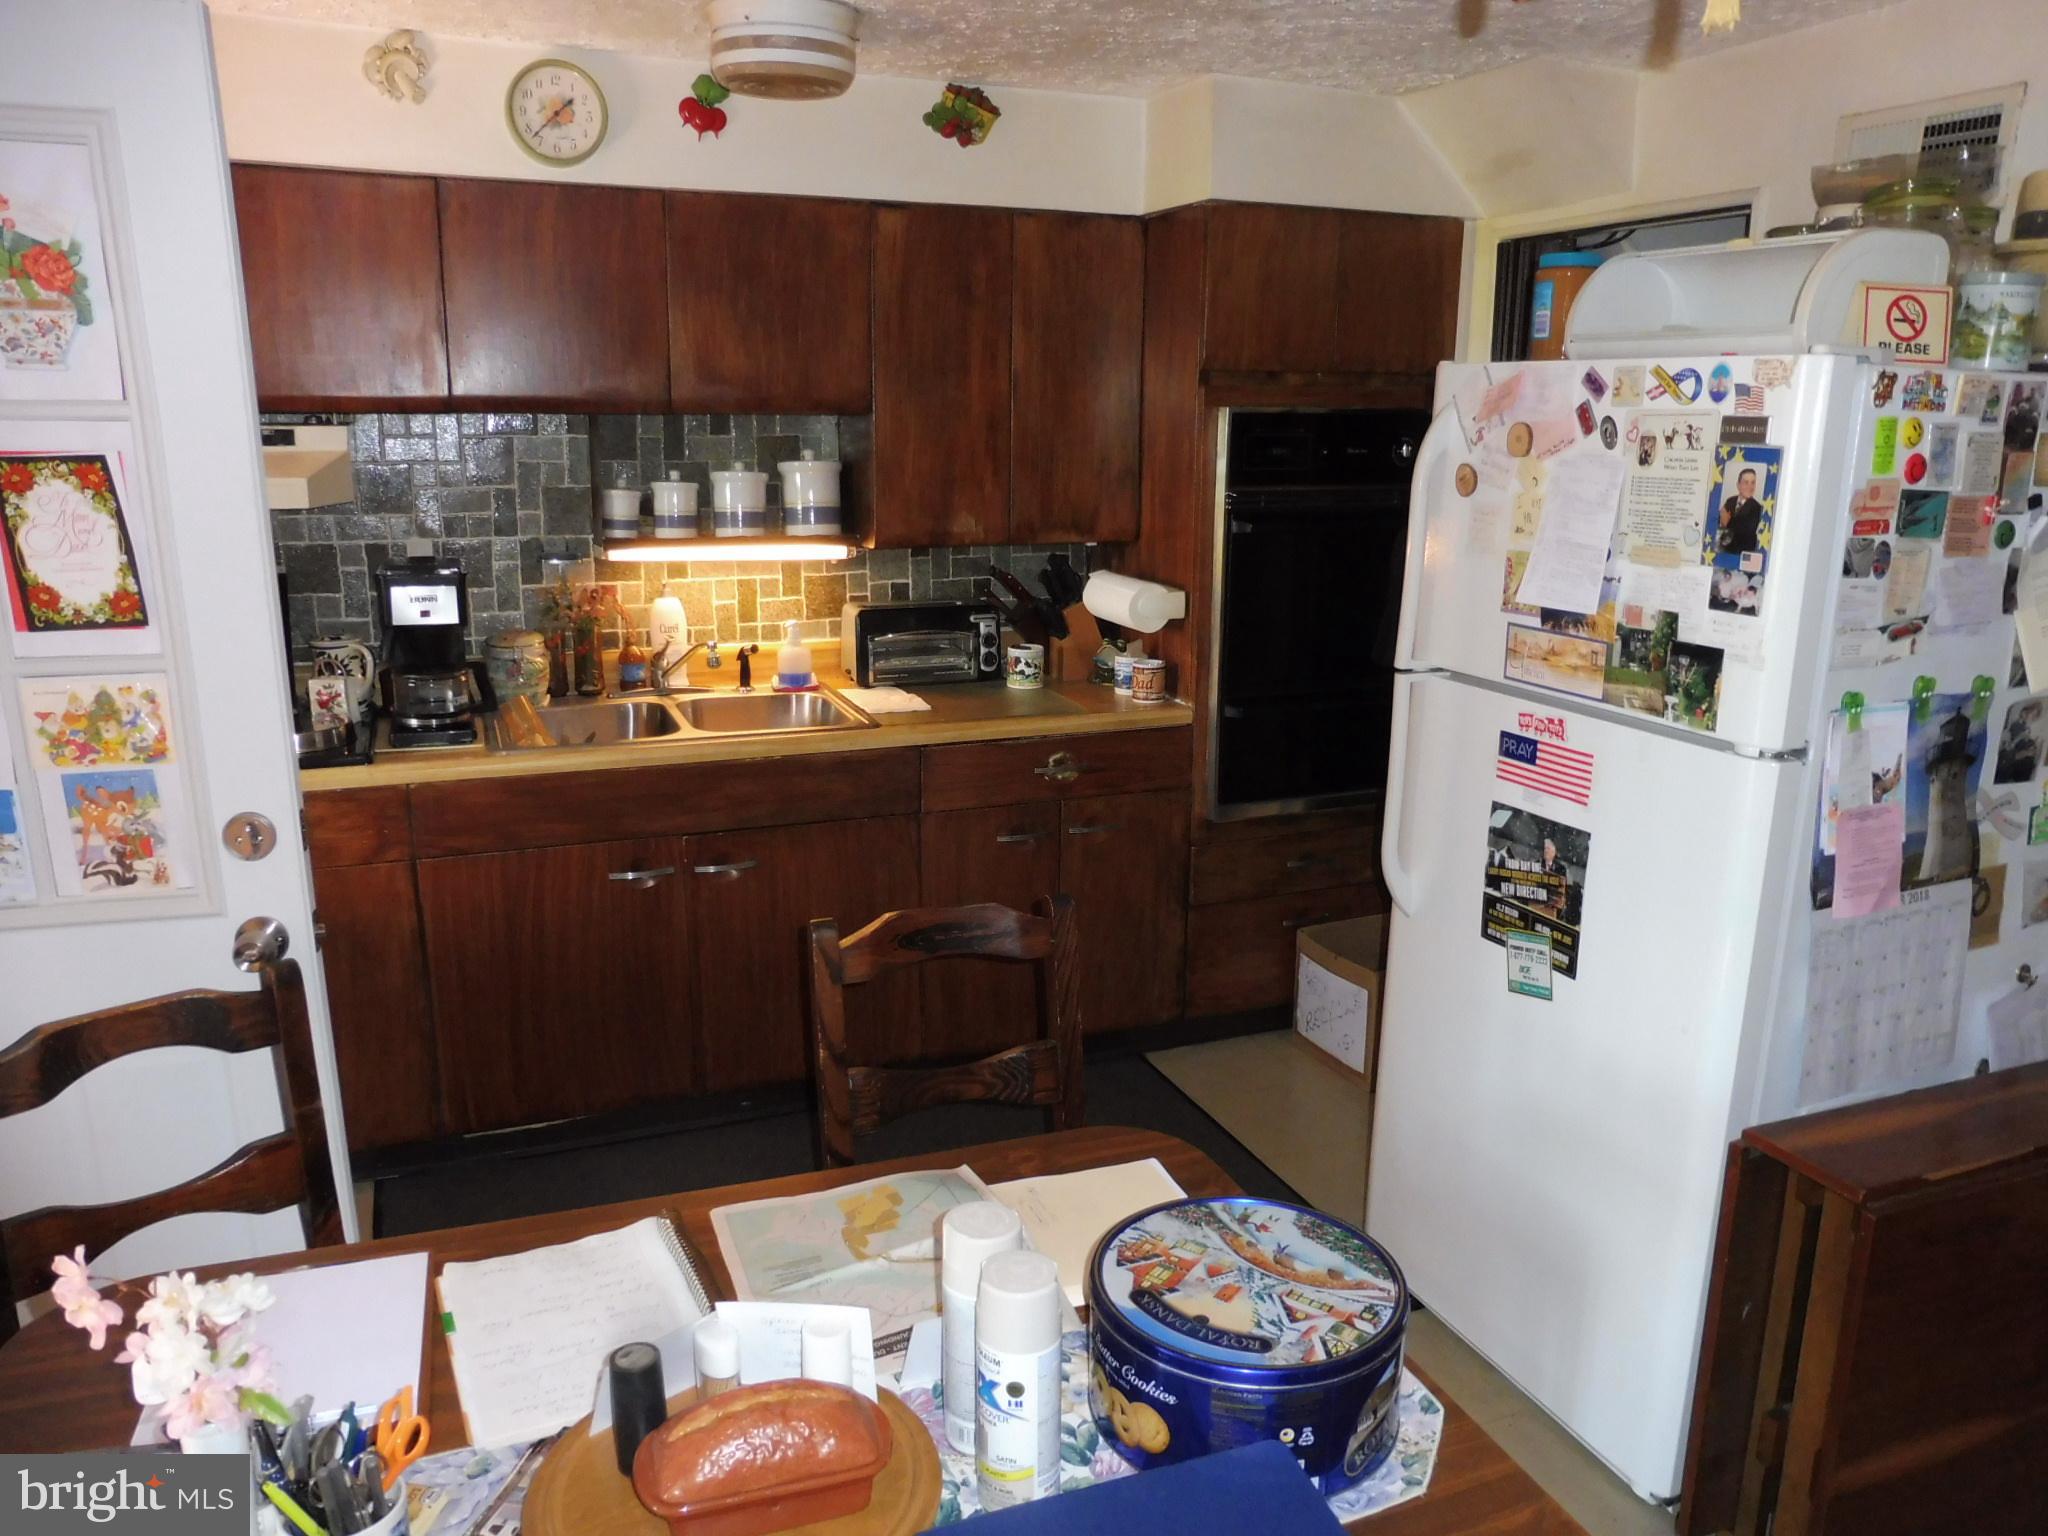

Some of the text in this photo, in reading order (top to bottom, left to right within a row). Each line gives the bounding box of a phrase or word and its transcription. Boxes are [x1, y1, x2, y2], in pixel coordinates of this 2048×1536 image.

[1878, 341, 1930, 355] PLEASE
[1503, 737, 1533, 759] PRAY
[1516, 884, 1548, 901] DIRECTION
[1907, 888, 1930, 904] 2018
[1139, 1294, 1261, 1350] ROYAL DANSK
[1121, 1364, 1180, 1406] Cookies
